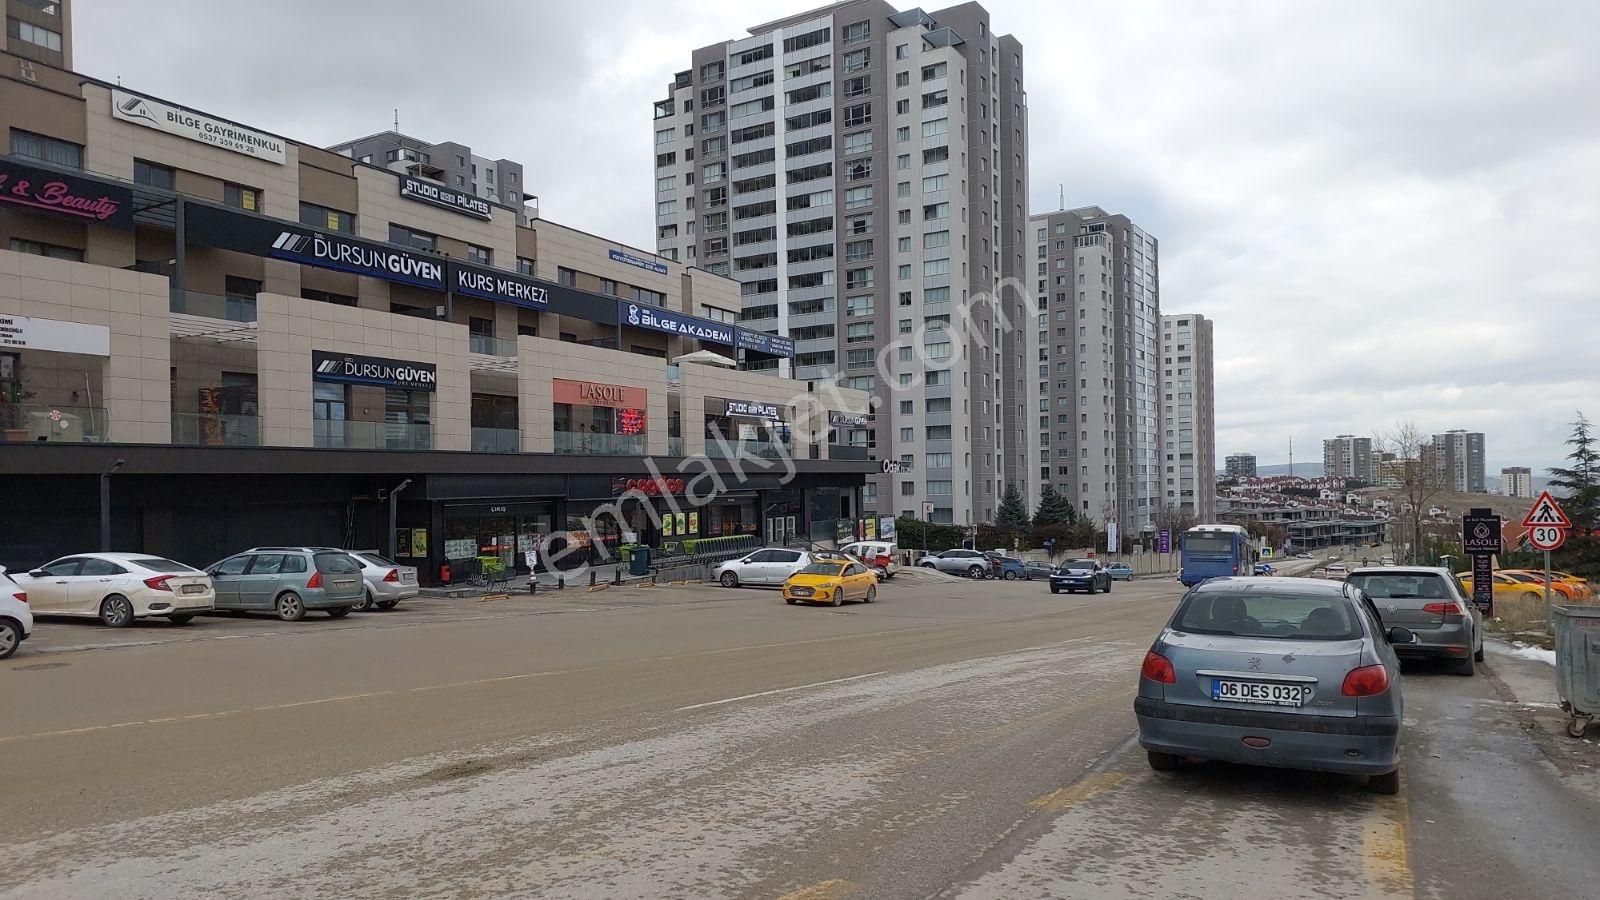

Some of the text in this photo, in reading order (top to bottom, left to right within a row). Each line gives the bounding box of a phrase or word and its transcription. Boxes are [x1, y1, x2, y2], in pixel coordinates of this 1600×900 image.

[166, 110, 283, 153] BİLGE GAYRİMENKUL
[198, 131, 217, 143] 0537
[219, 138, 233, 147] 359
[235, 142, 244, 150] 69
[11, 180, 30, 197] &
[35, 181, 120, 220] Beauty
[406, 179, 438, 199] STUDIO
[457, 193, 489, 214] PİLATES
[458, 270, 494, 292] KURS
[641, 313, 677, 331] BİLGE
[678, 323, 732, 342] AKADEMİ
[729, 402, 748, 413] STUDIO
[1536, 528, 1558, 542] 30
[1220, 683, 1300, 701] 06 DES 032
